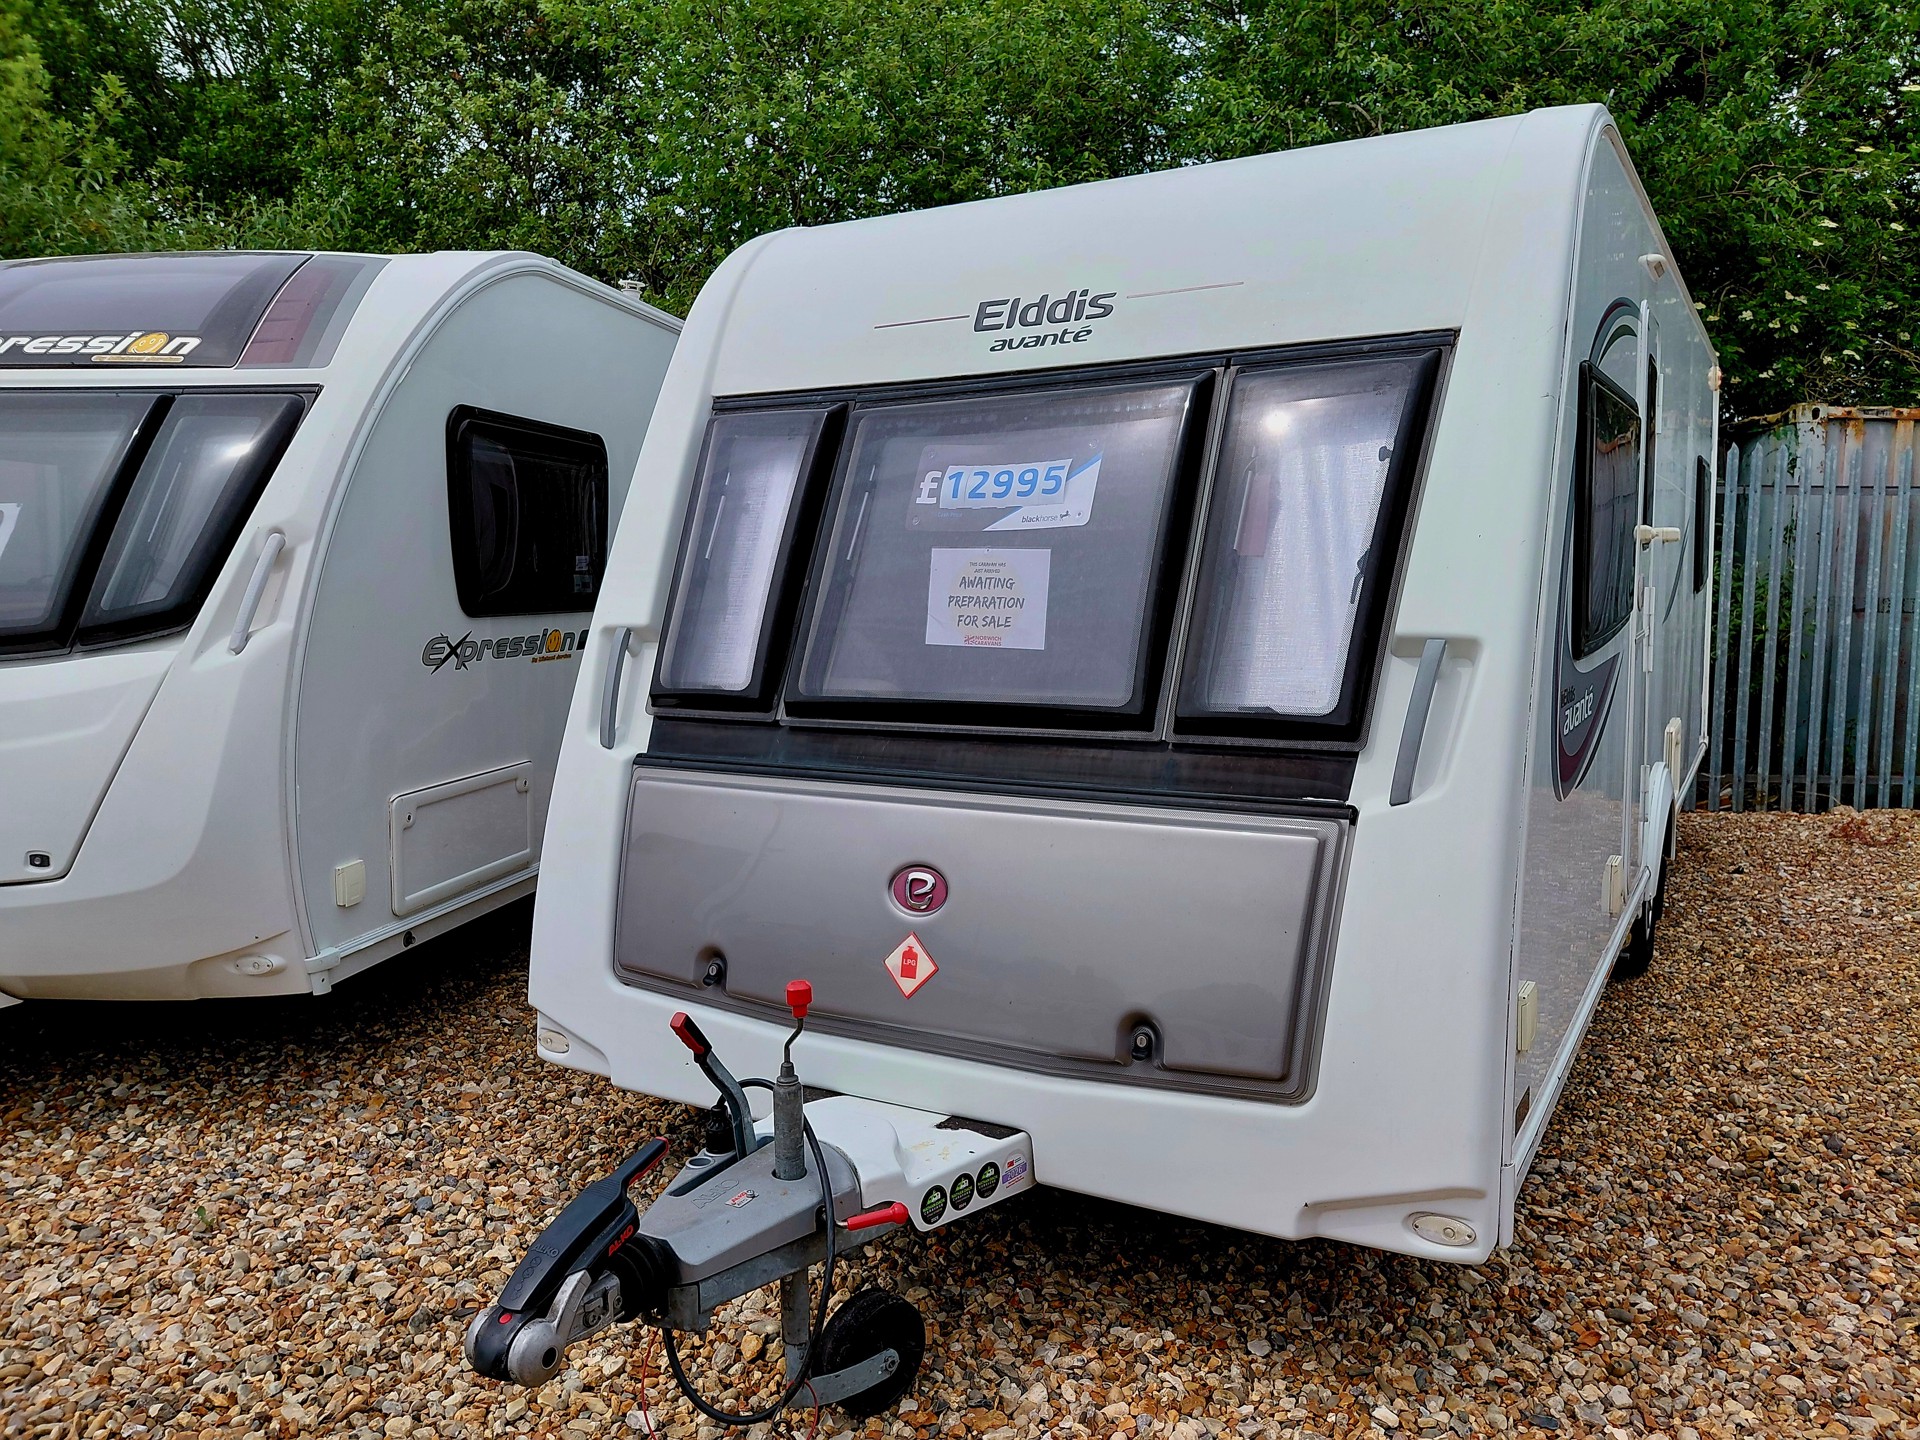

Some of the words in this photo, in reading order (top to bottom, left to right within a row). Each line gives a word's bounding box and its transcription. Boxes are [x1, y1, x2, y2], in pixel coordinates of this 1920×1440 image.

[974, 289, 1117, 332] Elddis
[989, 324, 1093, 352] avanté
[1021, 513, 1058, 523] blackhorse
[959, 576, 1015, 590] AWAITING
[947, 595, 1025, 610] PREPARATION
[957, 615, 979, 628] FOR
[981, 616, 1012, 629] SALE
[1563, 684, 1594, 736] avanté
[903, 958, 916, 966] LPG
[1007, 1165, 1023, 1180] 2026
